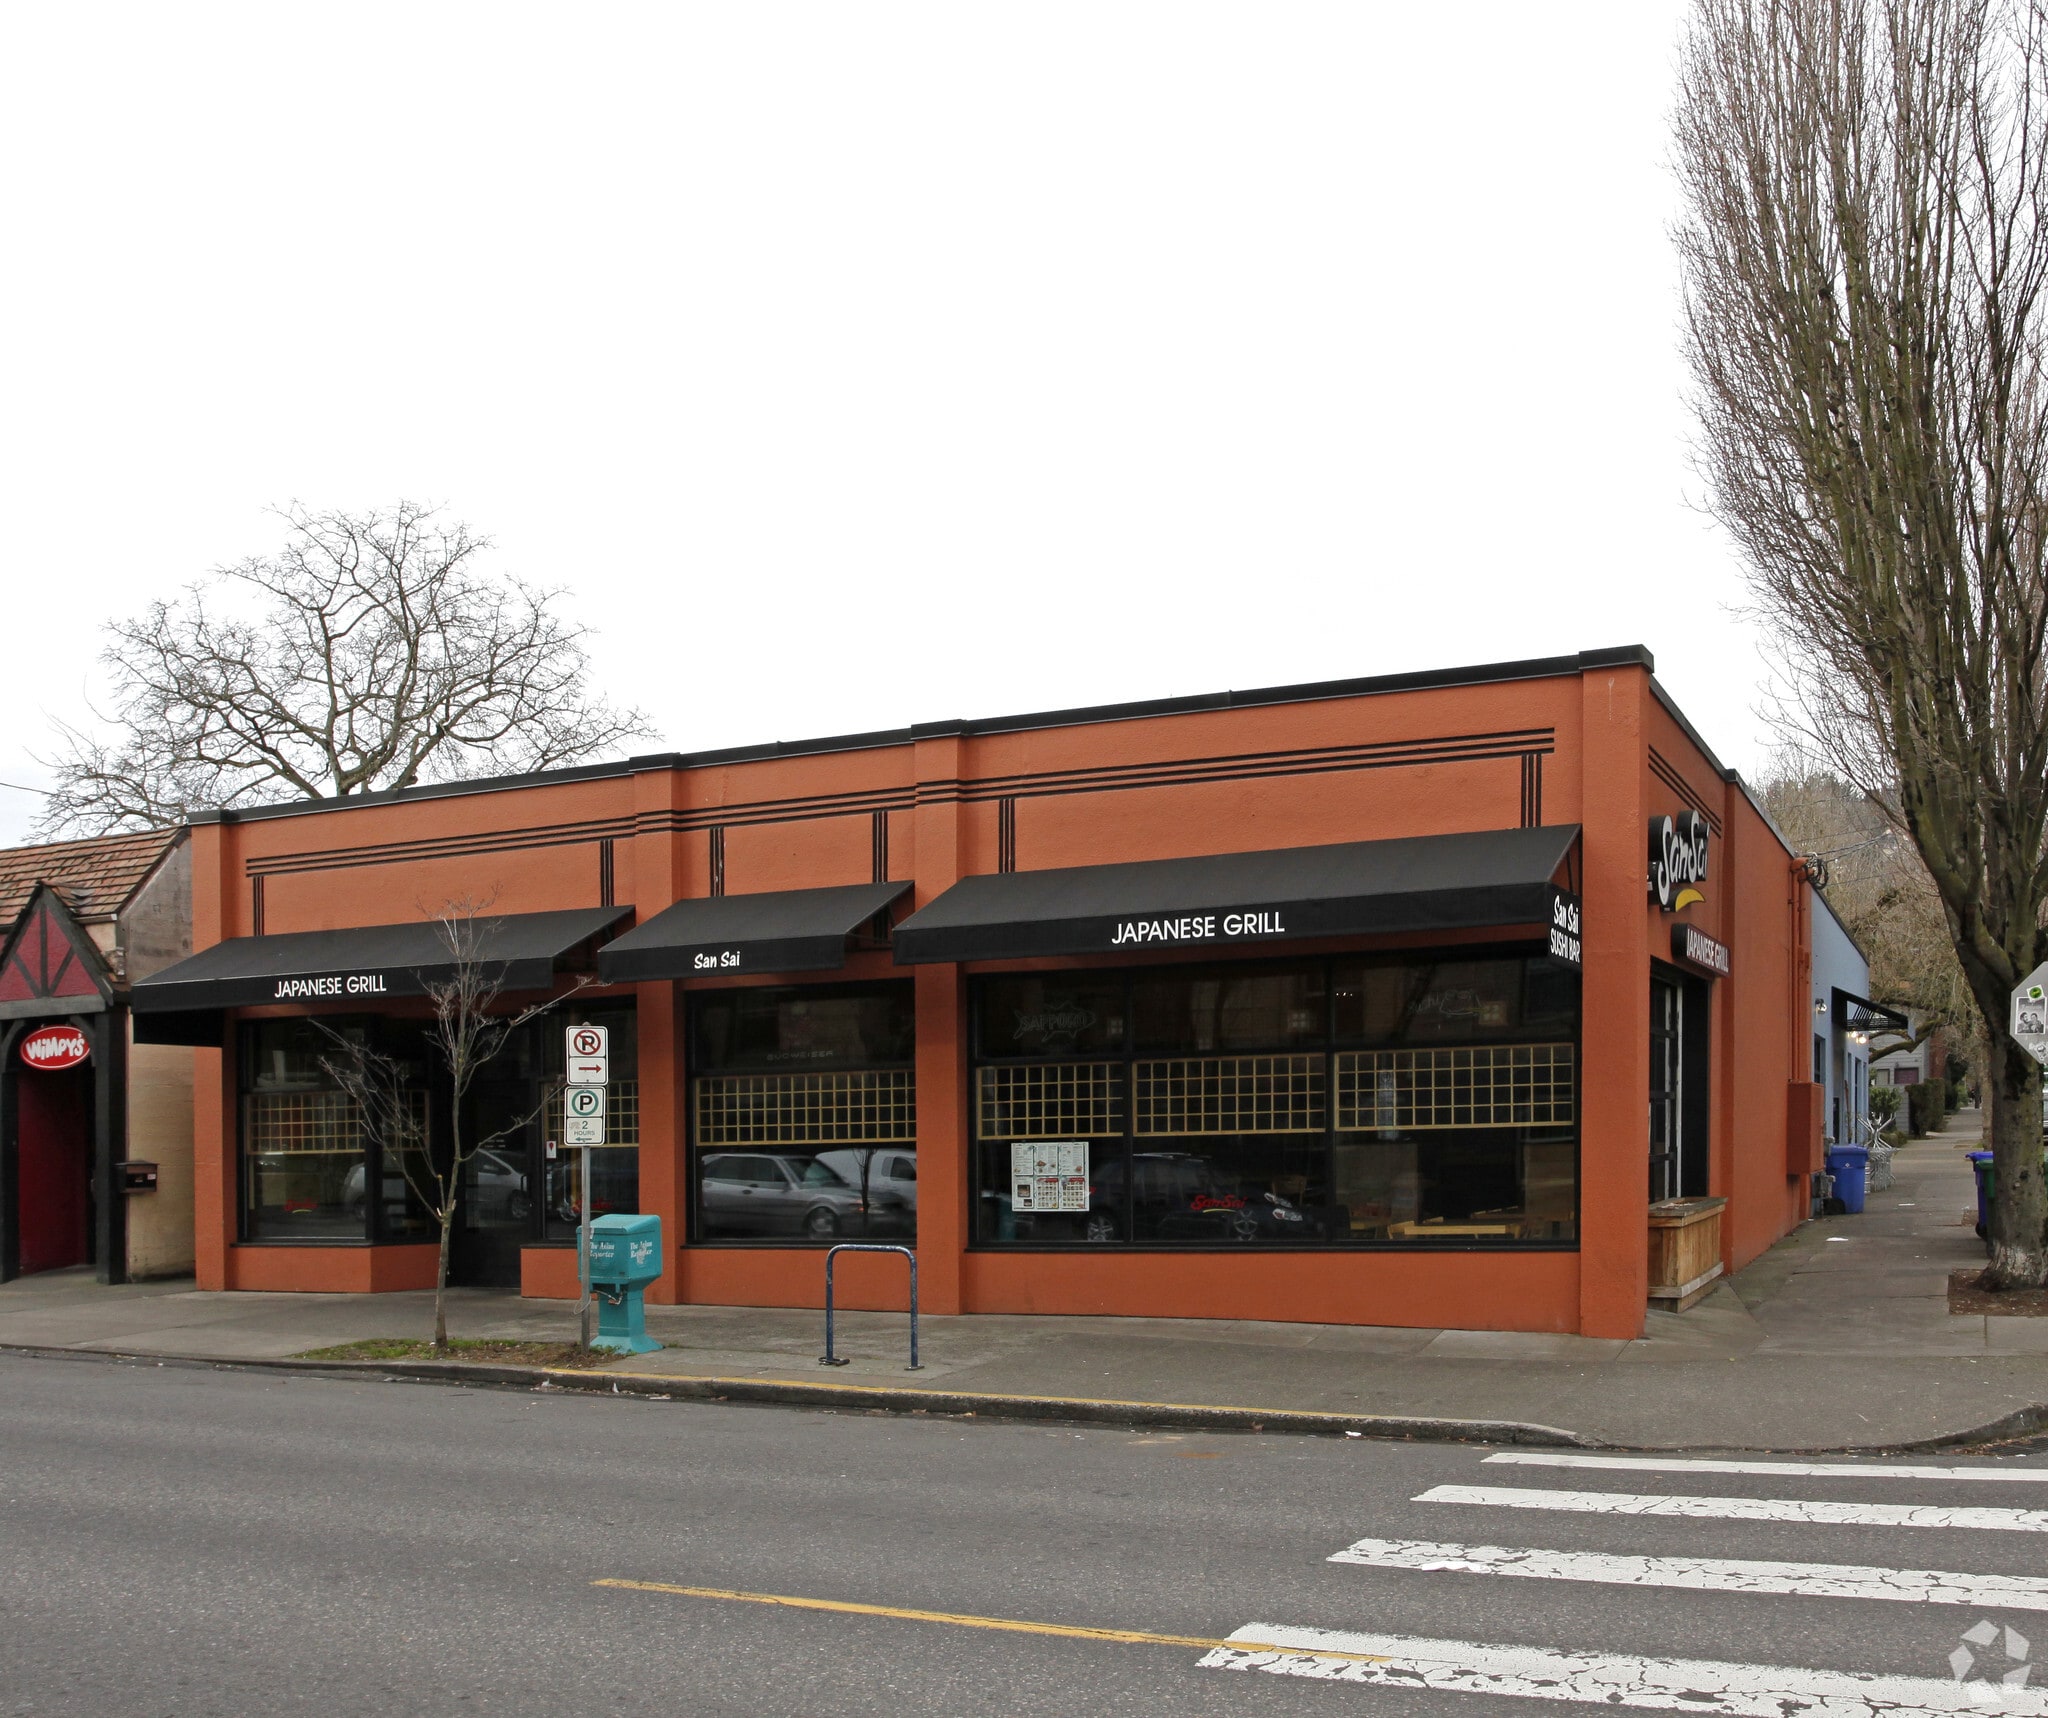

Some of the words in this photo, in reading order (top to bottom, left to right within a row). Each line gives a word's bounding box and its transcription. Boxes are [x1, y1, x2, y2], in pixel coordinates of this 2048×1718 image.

[1553, 894, 1567, 929] San
[1567, 903, 1579, 935] Sai
[1111, 915, 1216, 944] JAPANESE
[1223, 911, 1286, 936] GRILL
[1550, 927, 1569, 959] SUSHI
[1569, 937, 1581, 964] BAR
[1686, 927, 1715, 967] JAPANESE
[1714, 942, 1730, 974] GRILL
[694, 952, 718, 970] San
[720, 950, 741, 968] Sai
[274, 976, 342, 999] JAPANESE
[346, 974, 387, 994] GRILL
[579, 1095, 594, 1111] P
[581, 1120, 589, 1130] 2
[599, 1241, 615, 1250] Asian
[630, 1242, 639, 1250] The
